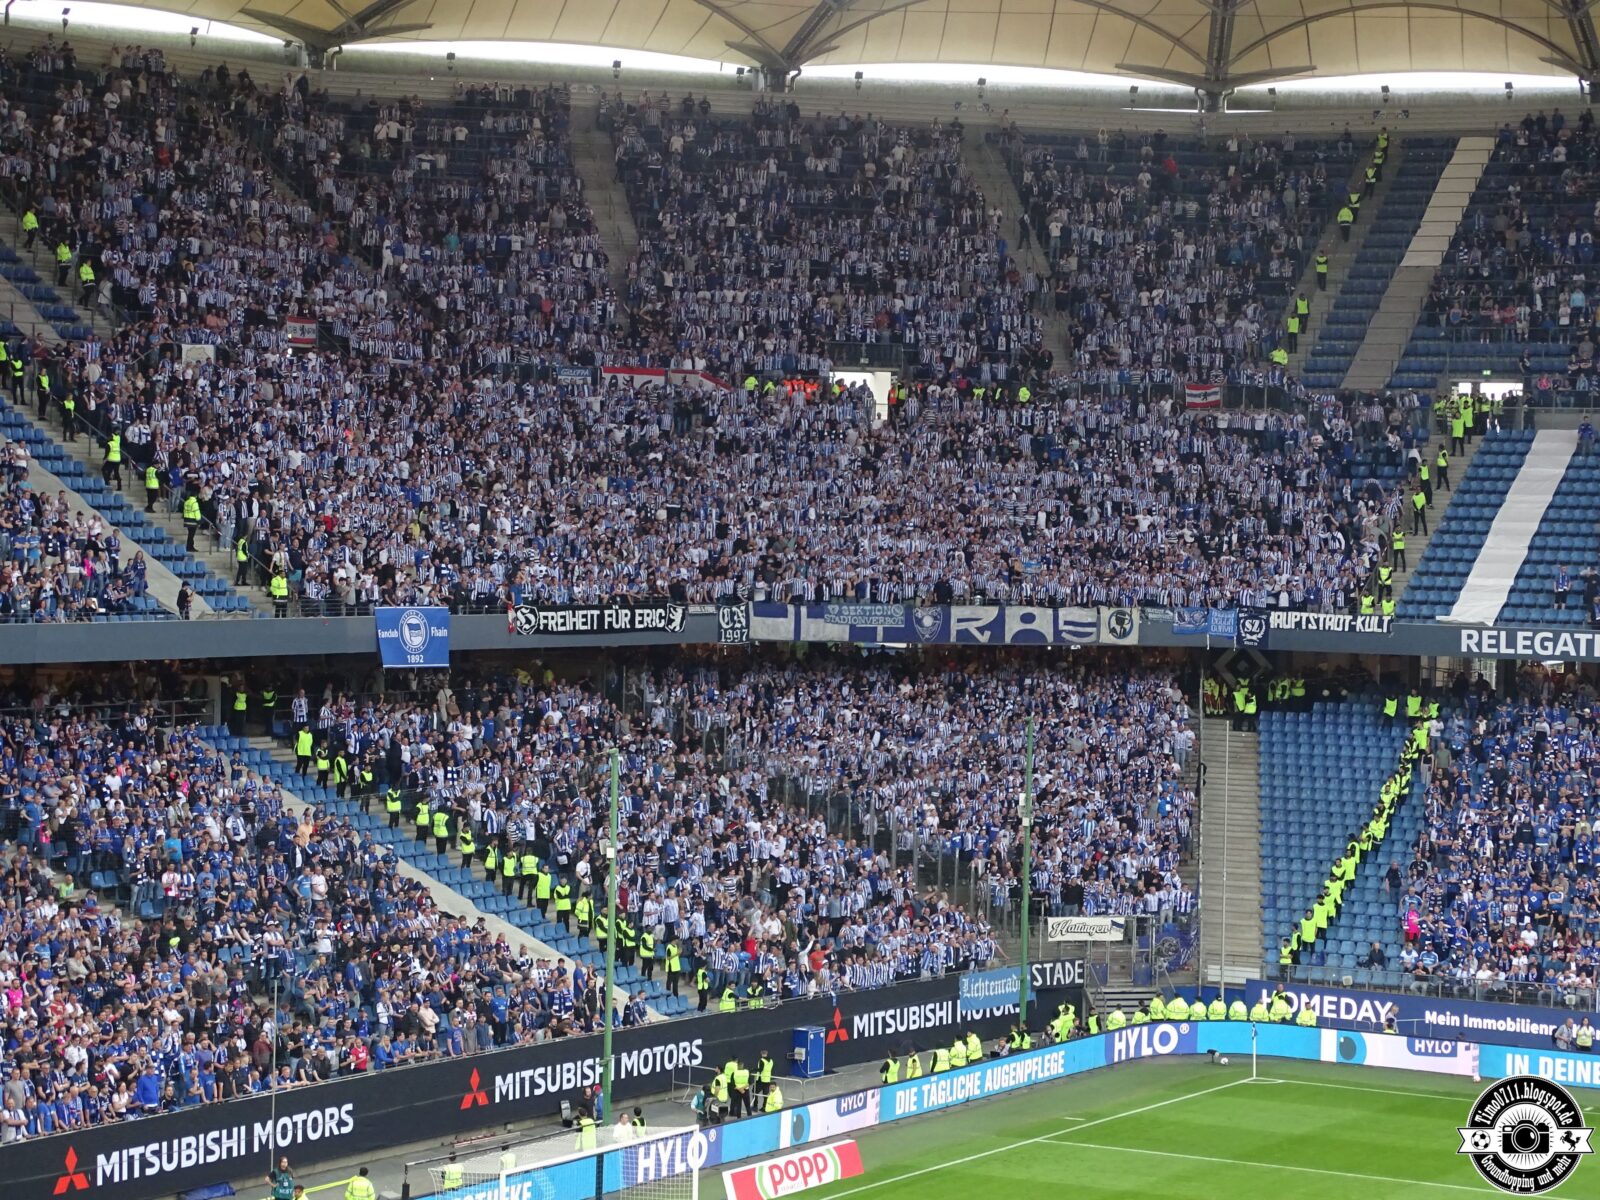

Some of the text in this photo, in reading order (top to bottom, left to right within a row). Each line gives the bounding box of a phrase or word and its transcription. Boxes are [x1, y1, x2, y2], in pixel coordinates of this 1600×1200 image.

[539, 605, 666, 632] FREIHEIT FÜR ERIC
[824, 614, 904, 625] STADIONVERBOT
[842, 605, 891, 615] SEKTION
[431, 626, 448, 637] Fhain
[720, 629, 748, 642] 1997
[407, 654, 424, 663] 1892
[1032, 960, 1084, 987] STADE
[853, 1000, 952, 1040] MITSUBISHI
[1425, 1010, 1460, 1027] Mein
[620, 1038, 703, 1079] MOTORS
[1506, 1053, 1529, 1076] IN
[895, 1050, 1065, 1116] DIE TÄGLICHE AUGENPFLEGE
[96, 1103, 354, 1187] MITSUBISHI MOTORS
[768, 1152, 828, 1196] popp
